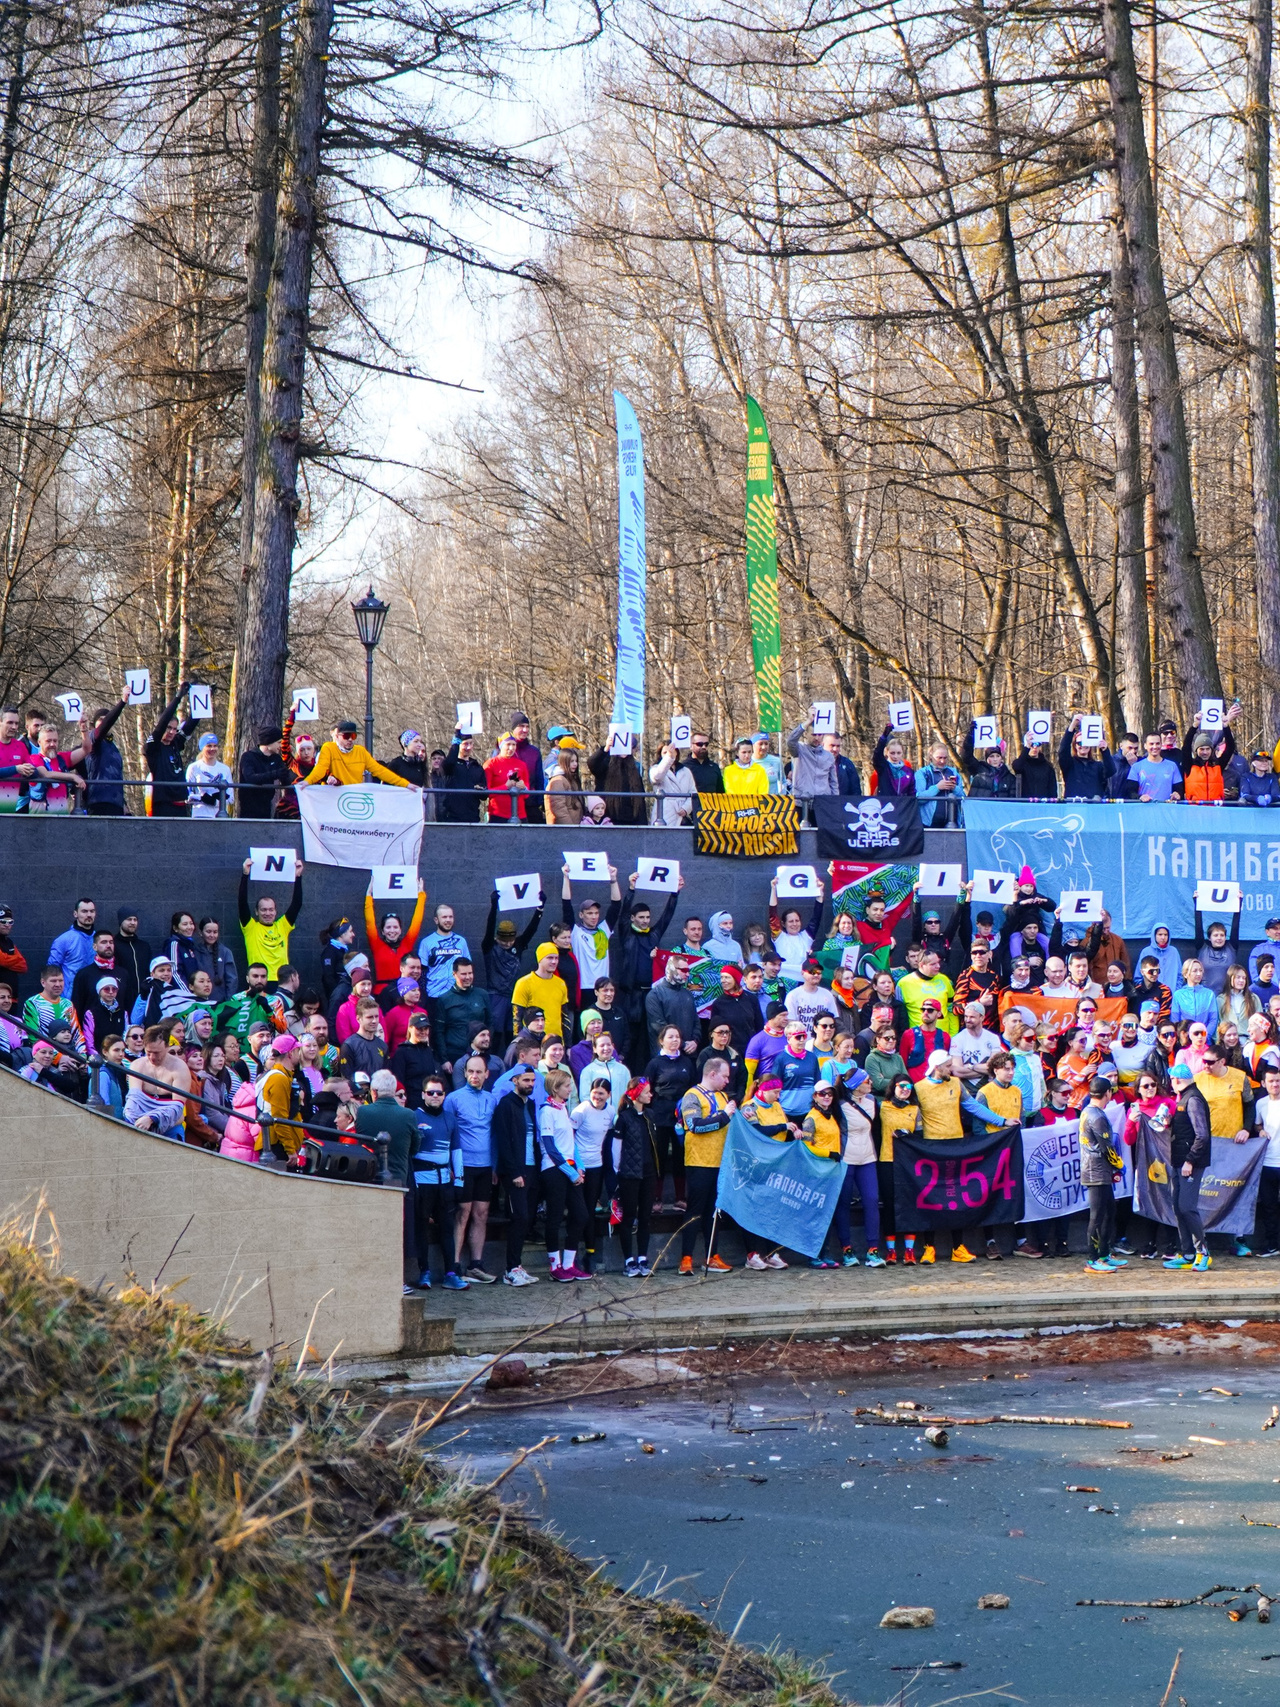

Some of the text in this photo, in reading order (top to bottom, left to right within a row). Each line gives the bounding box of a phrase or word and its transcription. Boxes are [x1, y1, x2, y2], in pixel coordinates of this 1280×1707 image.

[130, 678, 147, 697] U
[67, 698, 81, 713] R
[193, 693, 209, 711] N
[296, 696, 315, 713] N
[815, 709, 832, 725] H
[896, 709, 910, 726] E
[1205, 707, 1220, 723] S
[674, 725, 690, 741] G
[979, 725, 993, 741] R
[1032, 719, 1049, 736] O
[1086, 724, 1100, 740] E
[610, 730, 629, 749] N
[736, 808, 756, 817] RHR
[720, 812, 777, 833] HEROES
[320, 824, 395, 839] #переводчикибегут
[857, 831, 890, 840] RHR
[742, 832, 799, 856] RUSSIA
[847, 837, 900, 848] ULTRAS
[264, 855, 286, 873] N
[582, 857, 596, 872] E
[388, 873, 405, 890] E
[649, 865, 670, 883] R
[789, 873, 809, 889] G
[937, 871, 946, 887] I
[512, 882, 530, 900] V
[988, 878, 1005, 895] V
[1211, 888, 1230, 904] U
[1074, 898, 1091, 914] E
[237, 1000, 252, 1033] RUN
[915, 1148, 1016, 1210] 2.54
[766, 1172, 826, 1209] КАПИБАРА
